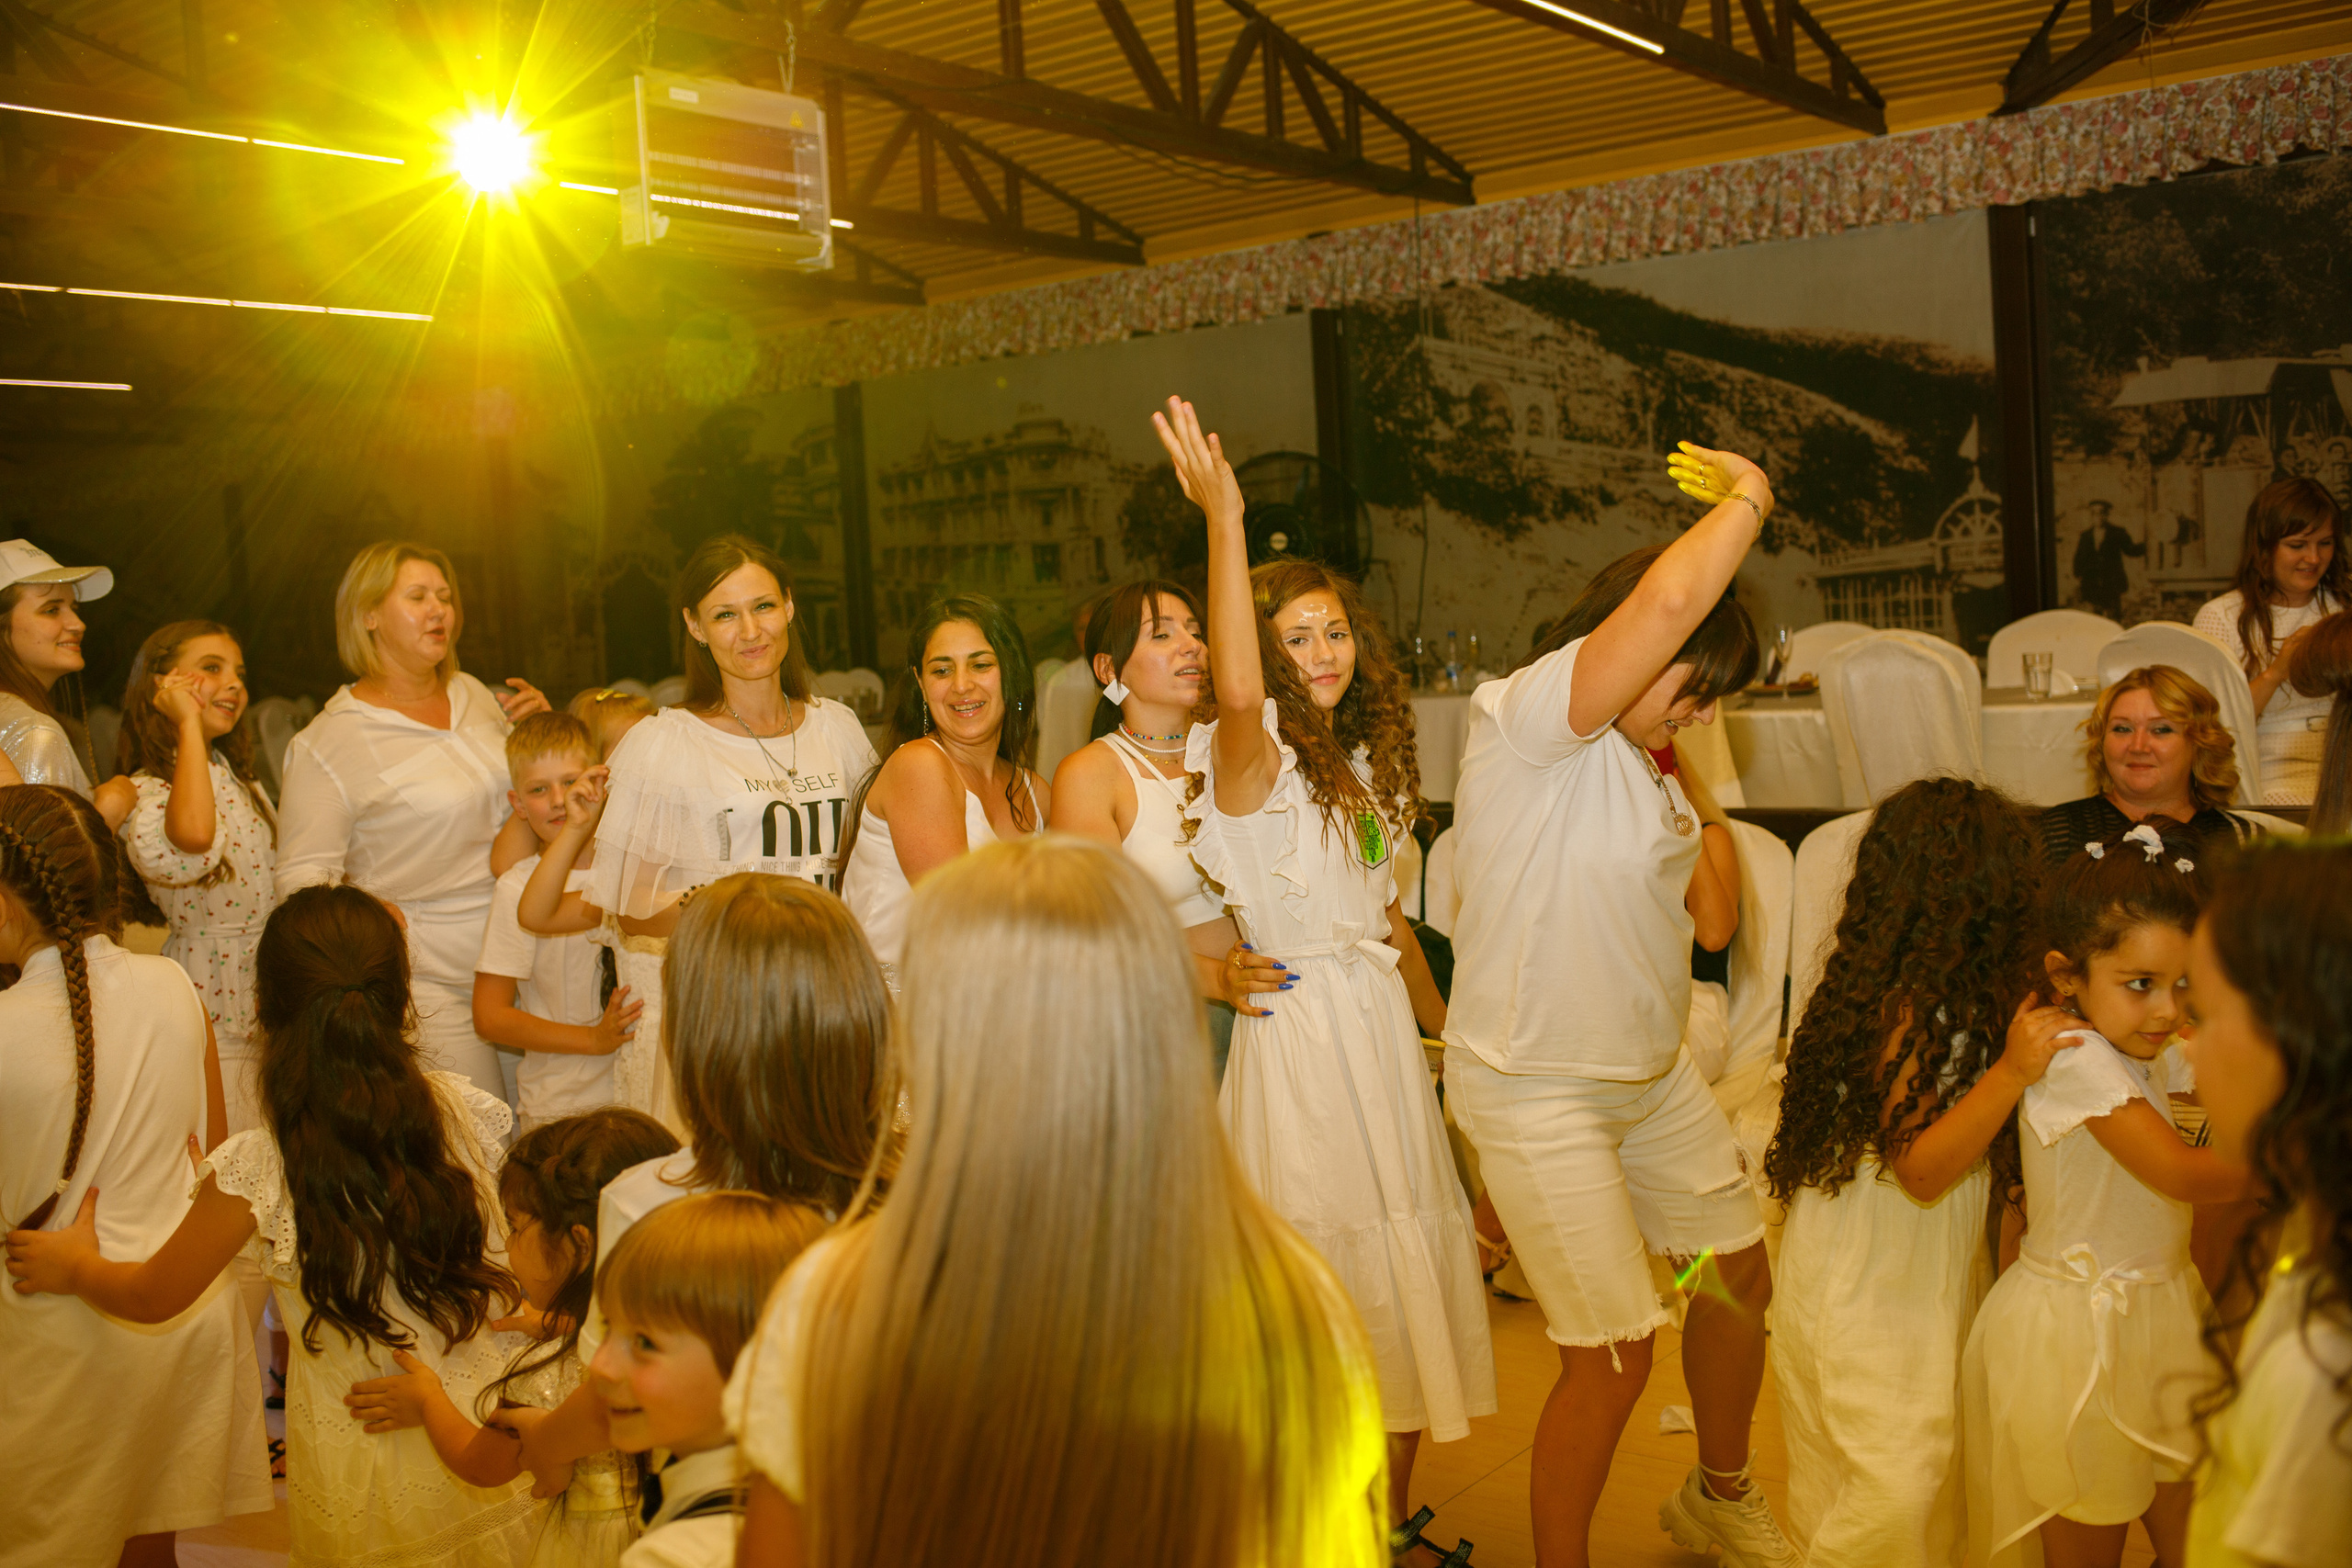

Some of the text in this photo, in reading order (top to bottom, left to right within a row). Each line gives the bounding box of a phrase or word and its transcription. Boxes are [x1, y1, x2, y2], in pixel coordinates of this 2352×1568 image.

[744, 773, 839, 793] MY SELF
[761, 861, 778, 873] NICE
[780, 861, 801, 873] THING
